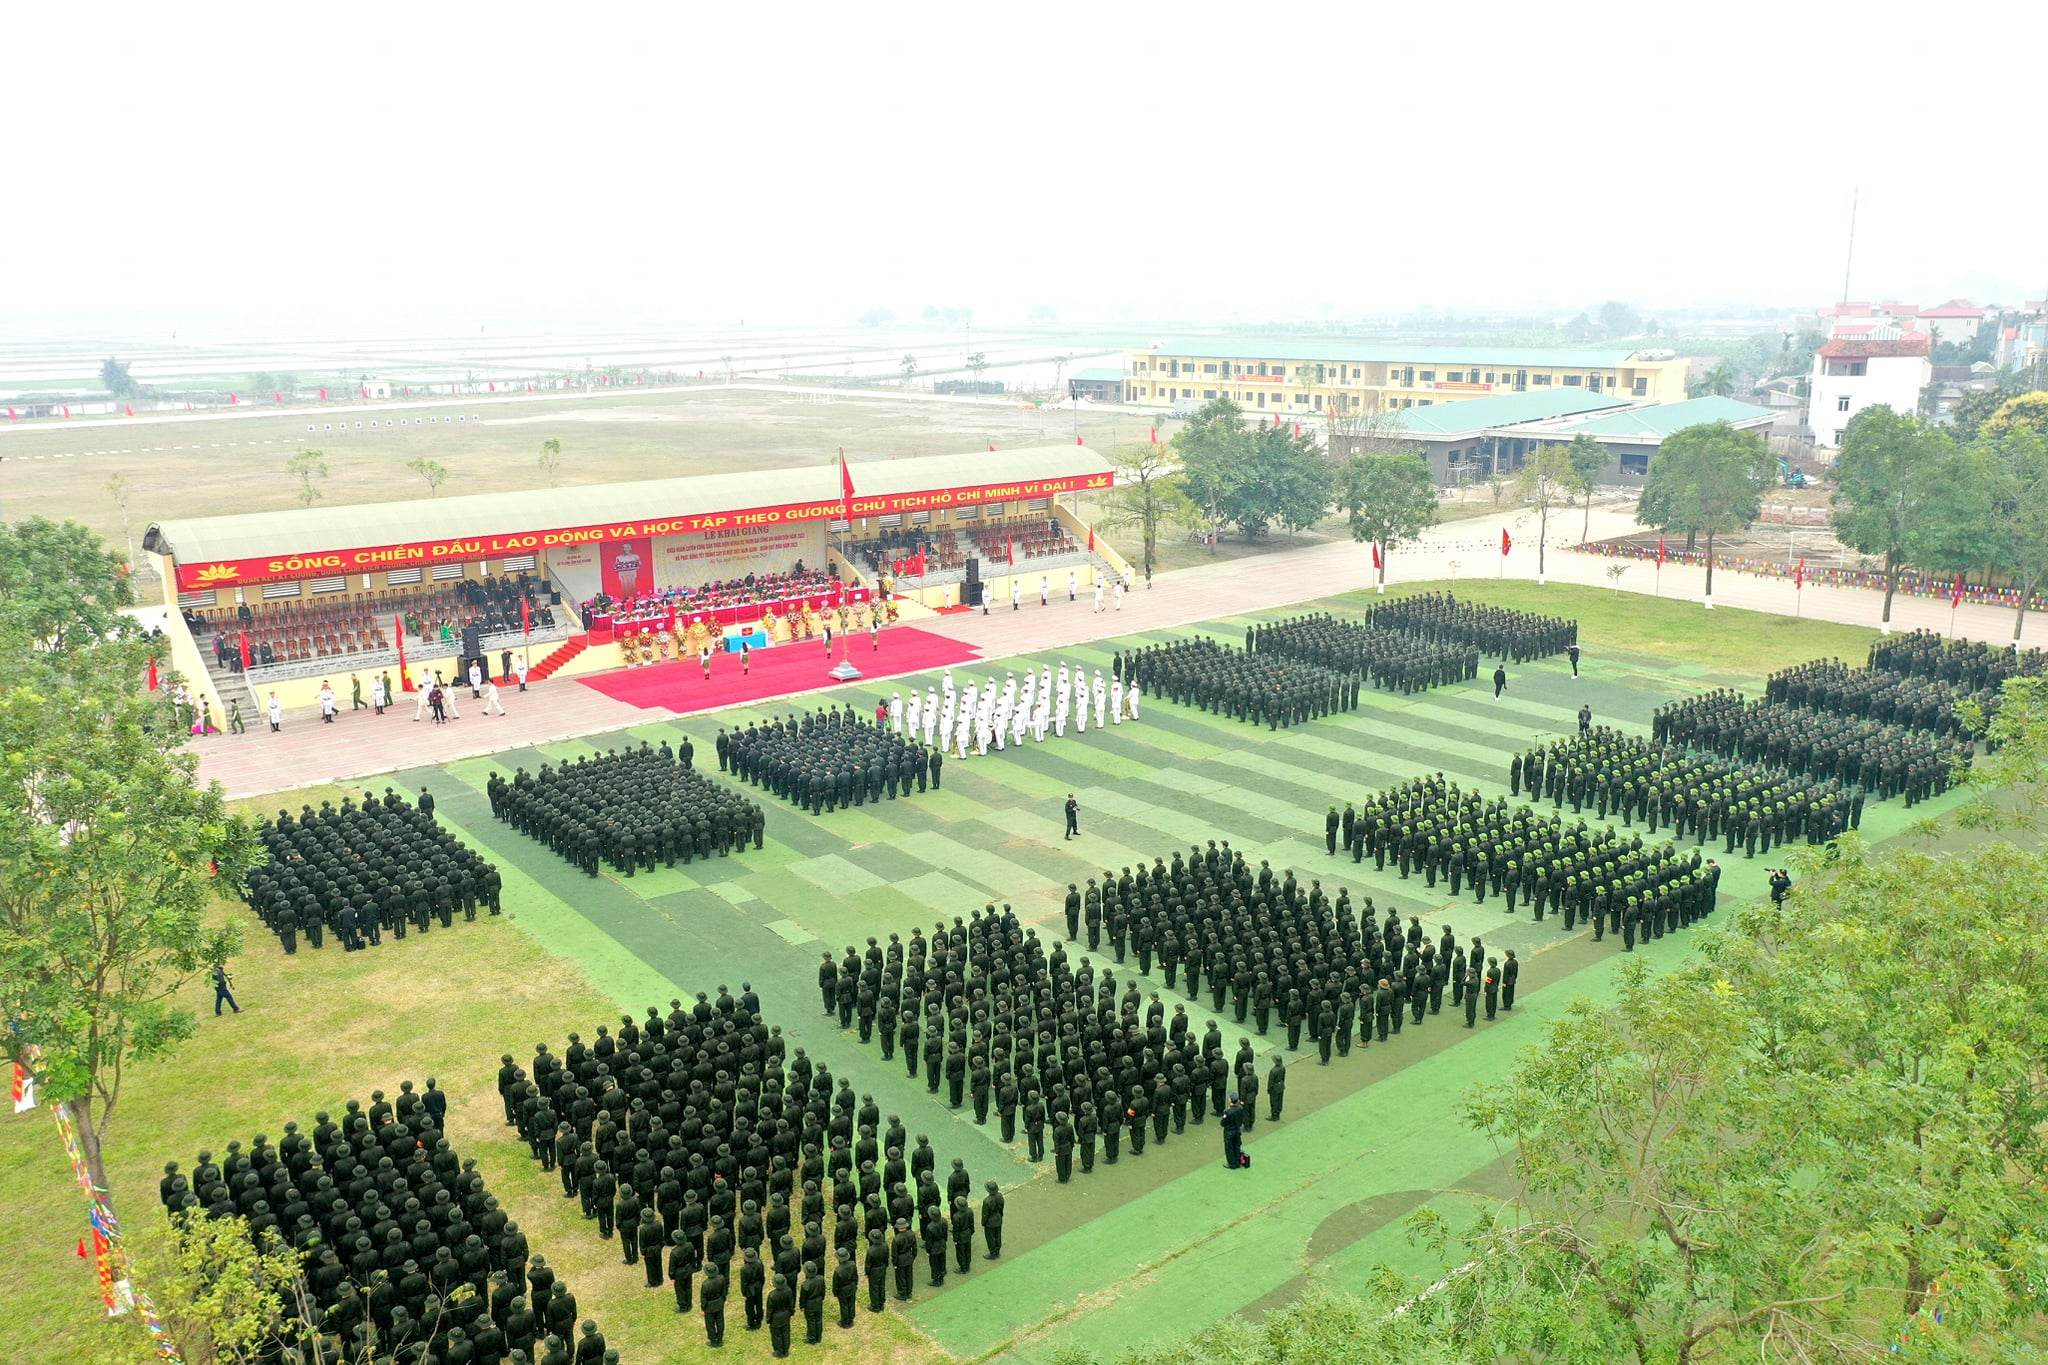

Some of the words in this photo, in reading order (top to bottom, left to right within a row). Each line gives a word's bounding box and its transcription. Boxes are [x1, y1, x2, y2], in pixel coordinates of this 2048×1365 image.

[492, 536, 537, 550] LAO
[544, 529, 604, 546] ĐỘNG
[609, 523, 637, 537] VÀ
[643, 521, 683, 535] HỌC
[690, 515, 727, 533] TẬP
[733, 511, 780, 525] THEO
[785, 504, 848, 520] GƯƠNG
[852, 496, 886, 513] CHỦ
[891, 495, 926, 510] TỊCH
[930, 488, 952, 504] HỒ
[956, 489, 980, 501] CHÍ
[984, 487, 1020, 498] MINH
[1024, 482, 1039, 494] VĨ
[1043, 481, 1067, 494] ĐẠI
[718, 527, 740, 539] KHAI
